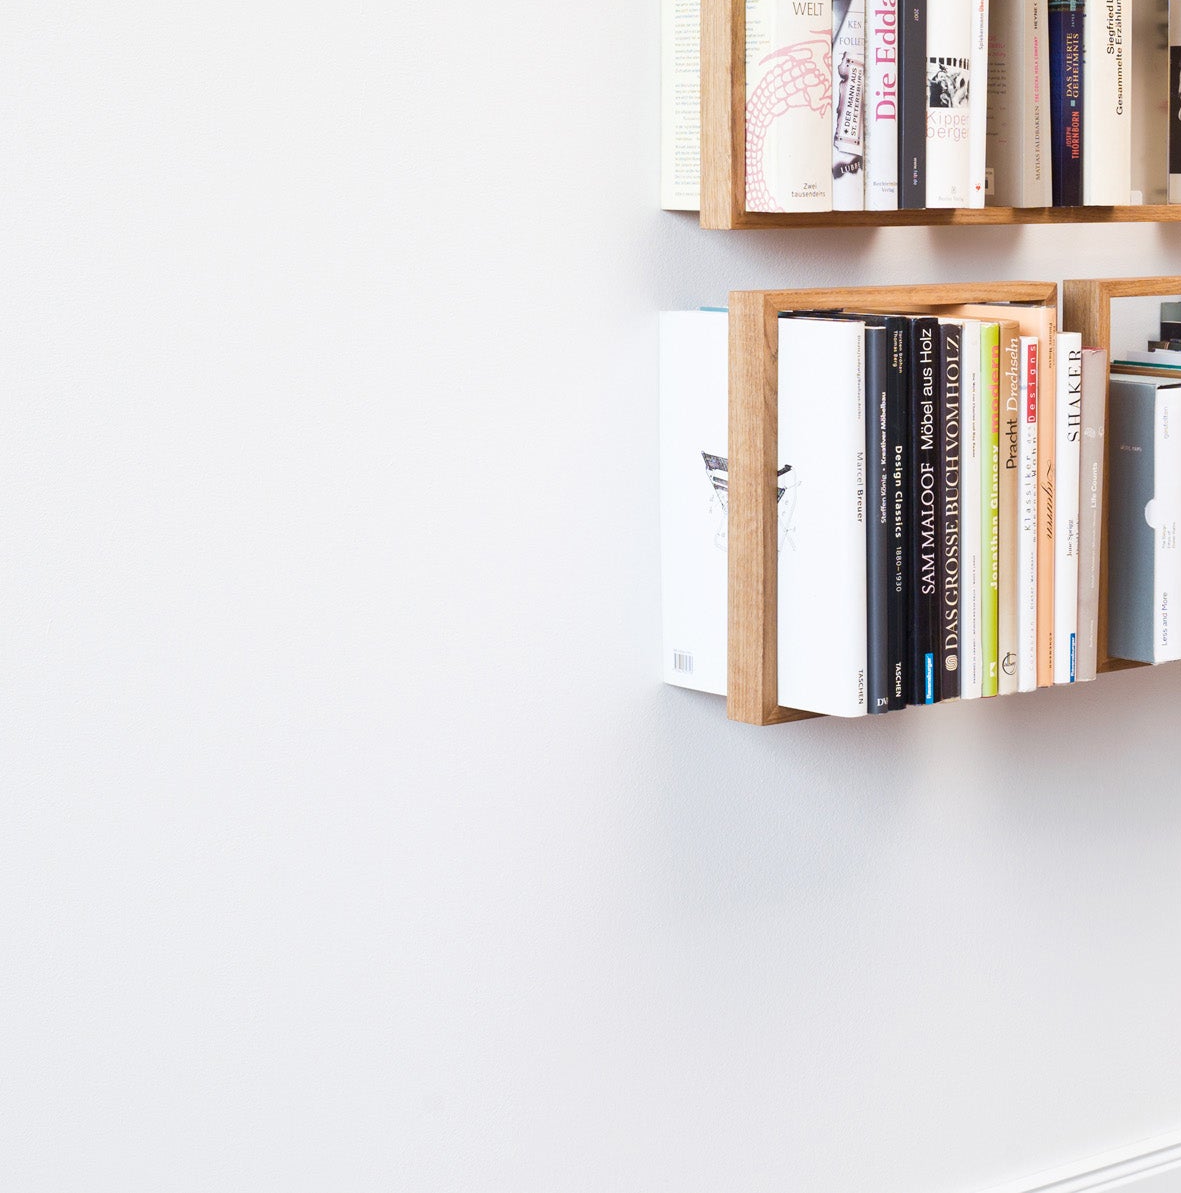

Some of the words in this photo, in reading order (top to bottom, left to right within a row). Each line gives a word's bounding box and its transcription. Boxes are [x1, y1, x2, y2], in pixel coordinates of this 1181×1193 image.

[792, 1, 824, 16] WELT
[848, 20, 862, 29] KEN
[1106, 5, 1115, 55] Siegfried
[847, 85, 855, 107] MANN
[853, 69, 862, 123] PETERSBURG
[875, 73, 897, 122] Die
[1115, 47, 1124, 116] Gesammelte
[1071, 111, 1080, 159] THORNBORN
[919, 328, 933, 363] Holz
[946, 335, 959, 399] HOLZ
[923, 367, 933, 397] aus
[988, 345, 999, 434] modern
[1005, 337, 1019, 412] Drechseln
[1027, 345, 1037, 422] Designs
[1066, 350, 1081, 442] SHAKER
[920, 401, 934, 450] Möbel
[945, 402, 959, 451] VOM
[1005, 418, 1018, 469] Pracht
[856, 452, 864, 486] Marcel
[880, 474, 888, 496] König
[892, 445, 903, 487] Design
[945, 455, 959, 516] BUCH
[894, 491, 903, 538] Classics
[920, 463, 935, 548] MALOOF
[921, 550, 936, 595] SAM
[945, 519, 959, 606] GROSSE
[989, 516, 998, 590] Jonathan
[944, 610, 958, 650] DAS
